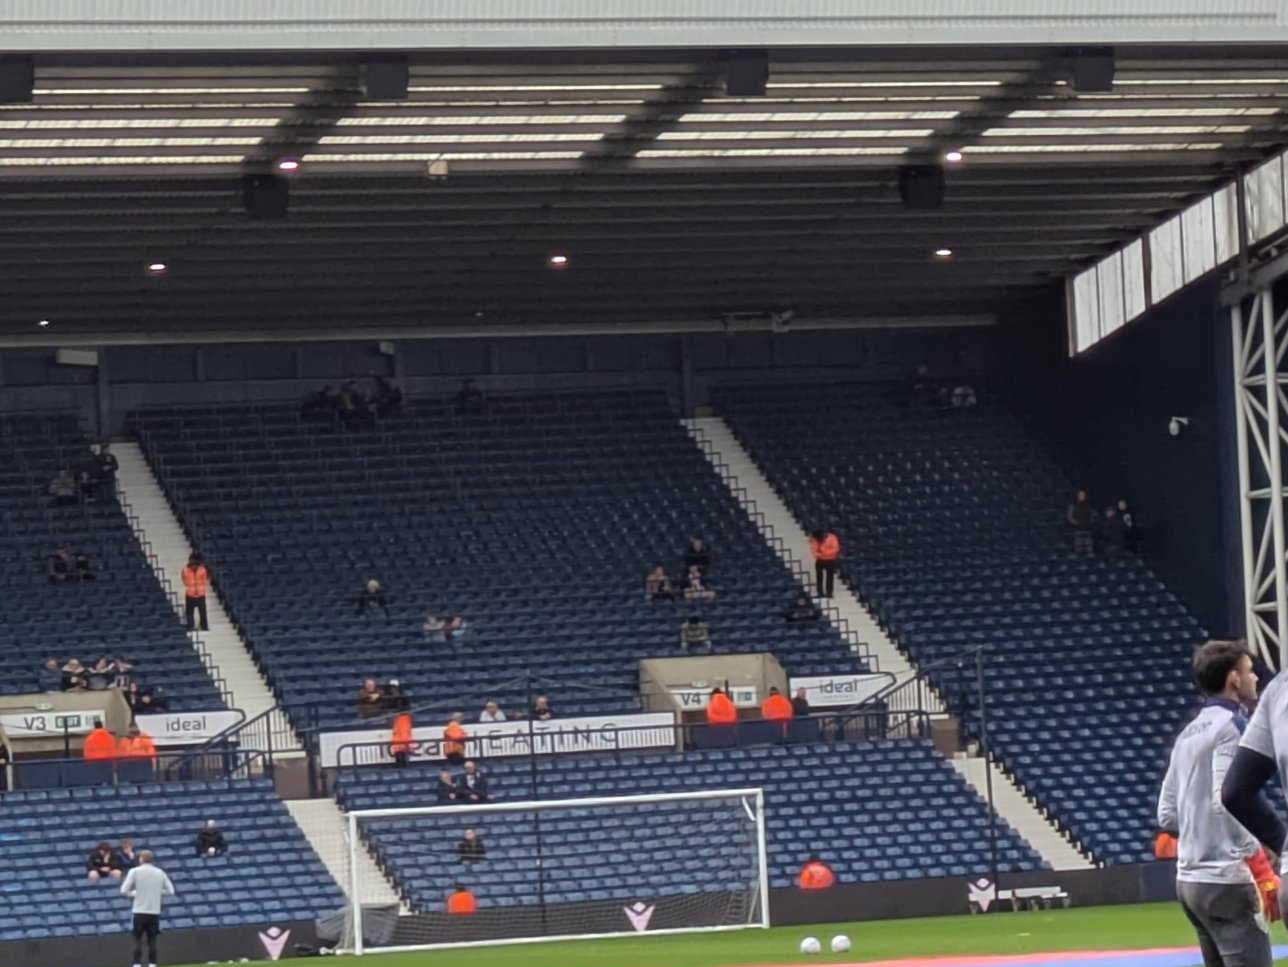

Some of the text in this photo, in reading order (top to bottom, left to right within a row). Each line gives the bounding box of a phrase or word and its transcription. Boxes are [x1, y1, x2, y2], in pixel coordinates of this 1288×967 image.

[820, 678, 858, 694] ideal
[681, 692, 702, 706] V4
[23, 715, 47, 731] V3
[166, 715, 207, 732] ideal
